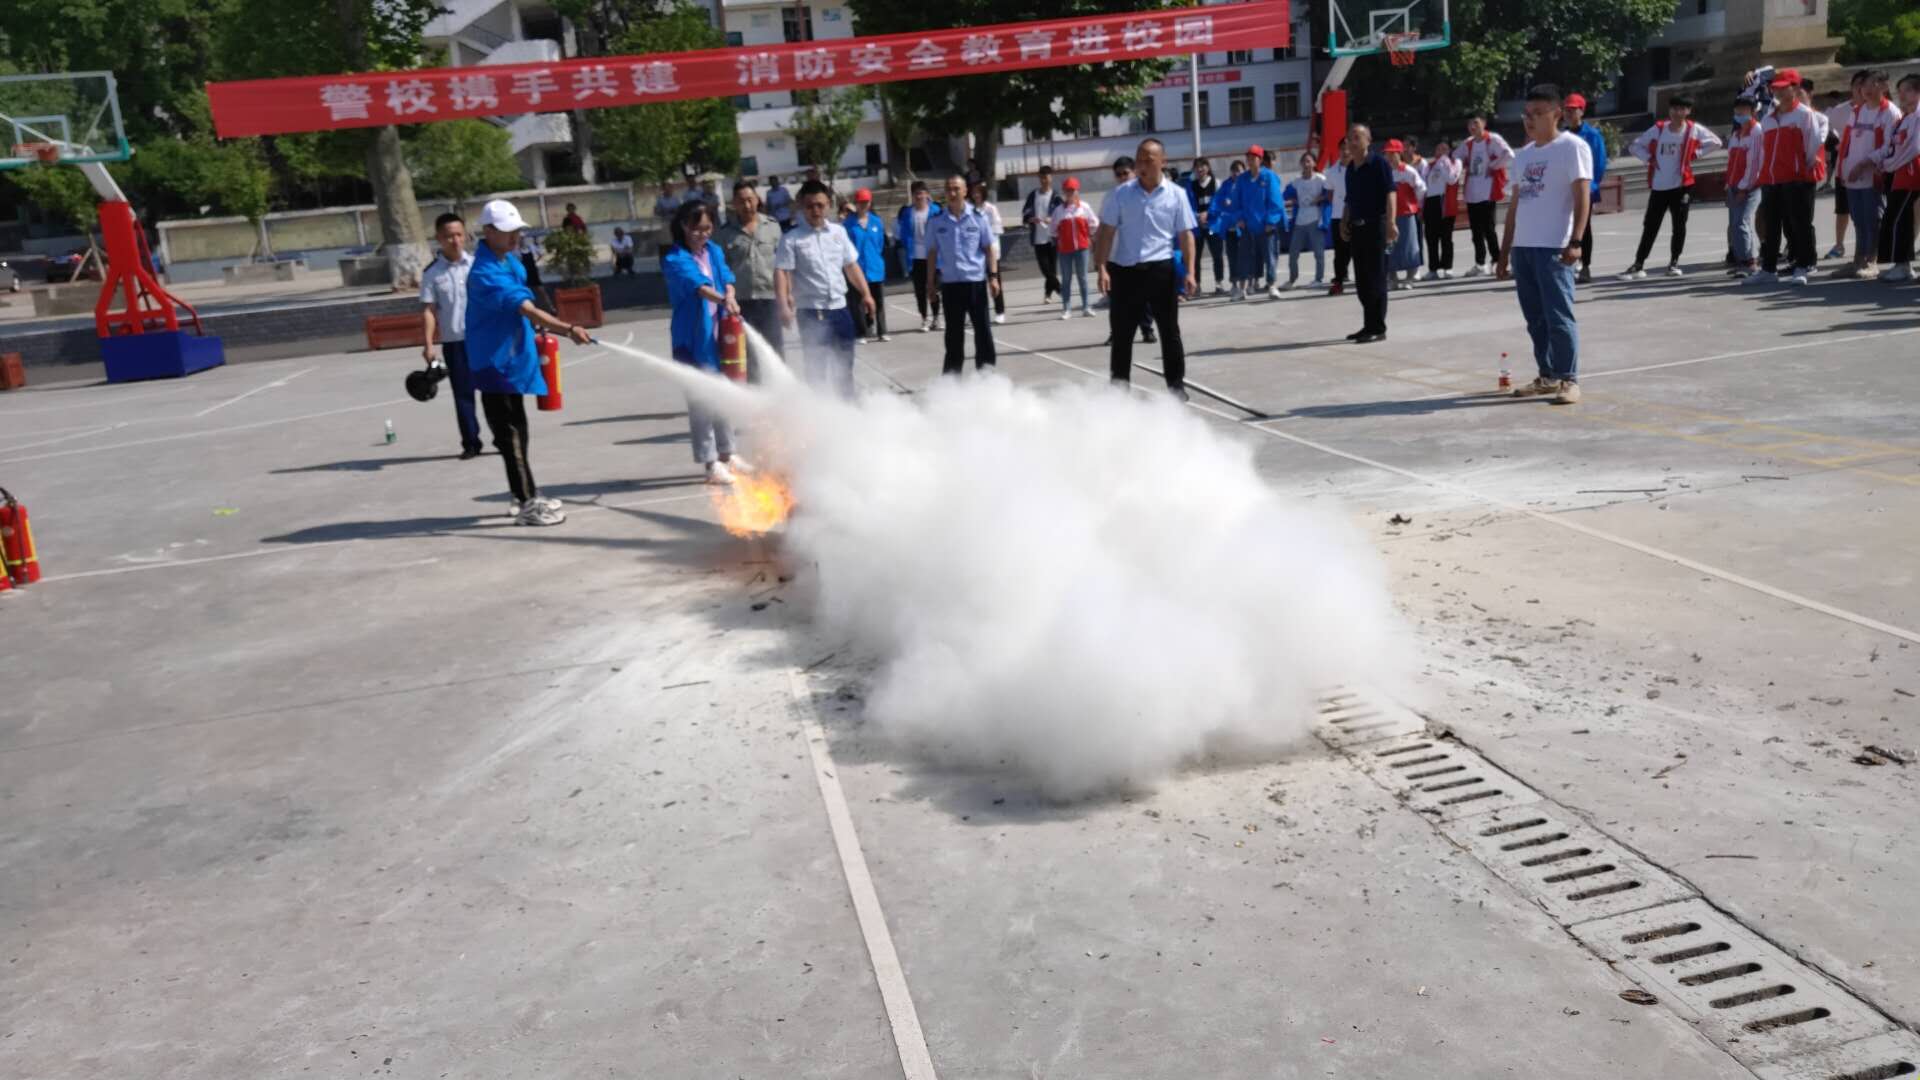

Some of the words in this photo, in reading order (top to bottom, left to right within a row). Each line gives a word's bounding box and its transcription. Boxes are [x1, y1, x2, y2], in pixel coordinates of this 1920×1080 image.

[321, 62, 680, 121] 警校携手共建
[737, 16, 1214, 87] 消防安全教育进校园
